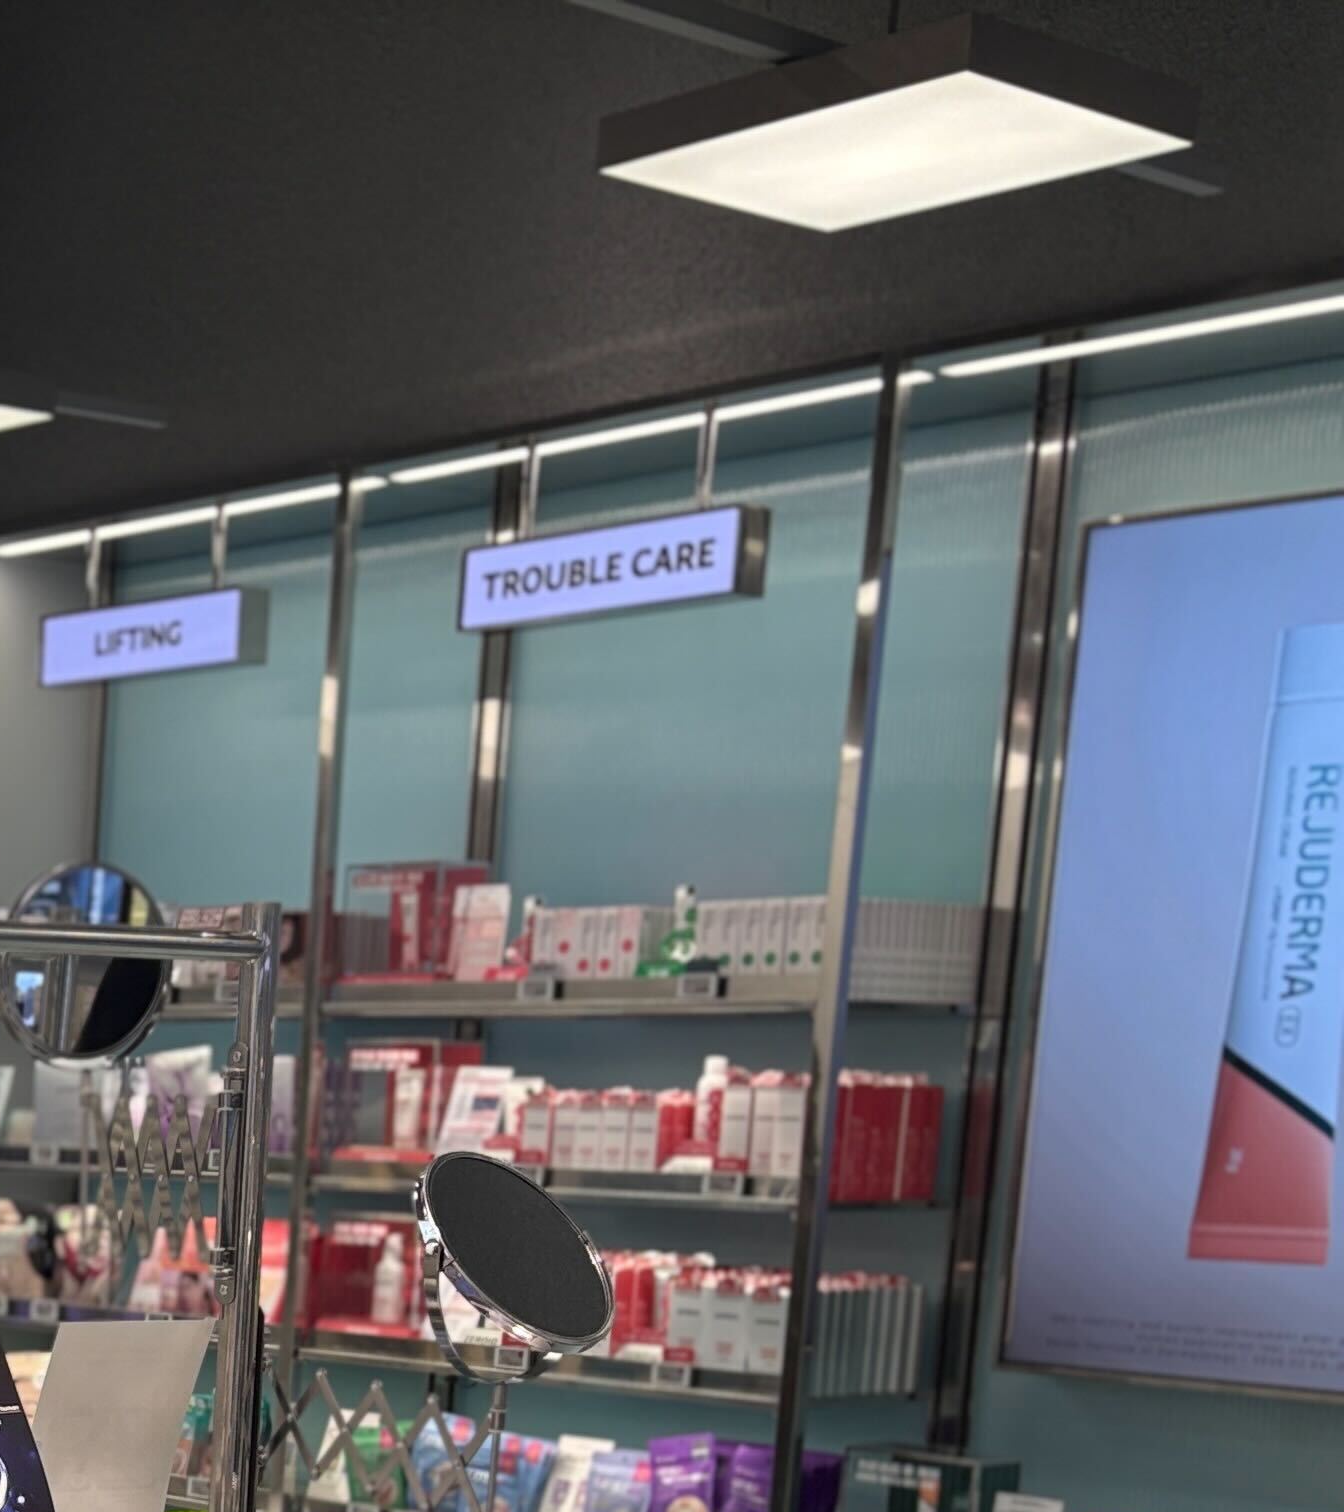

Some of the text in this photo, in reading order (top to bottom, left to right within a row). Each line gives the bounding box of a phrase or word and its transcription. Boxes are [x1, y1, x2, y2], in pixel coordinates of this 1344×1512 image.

[482, 538, 717, 601] TROUBLE CARE
[94, 620, 182, 658] LIFTING
[1280, 763, 1342, 1001] REJUDERMA
